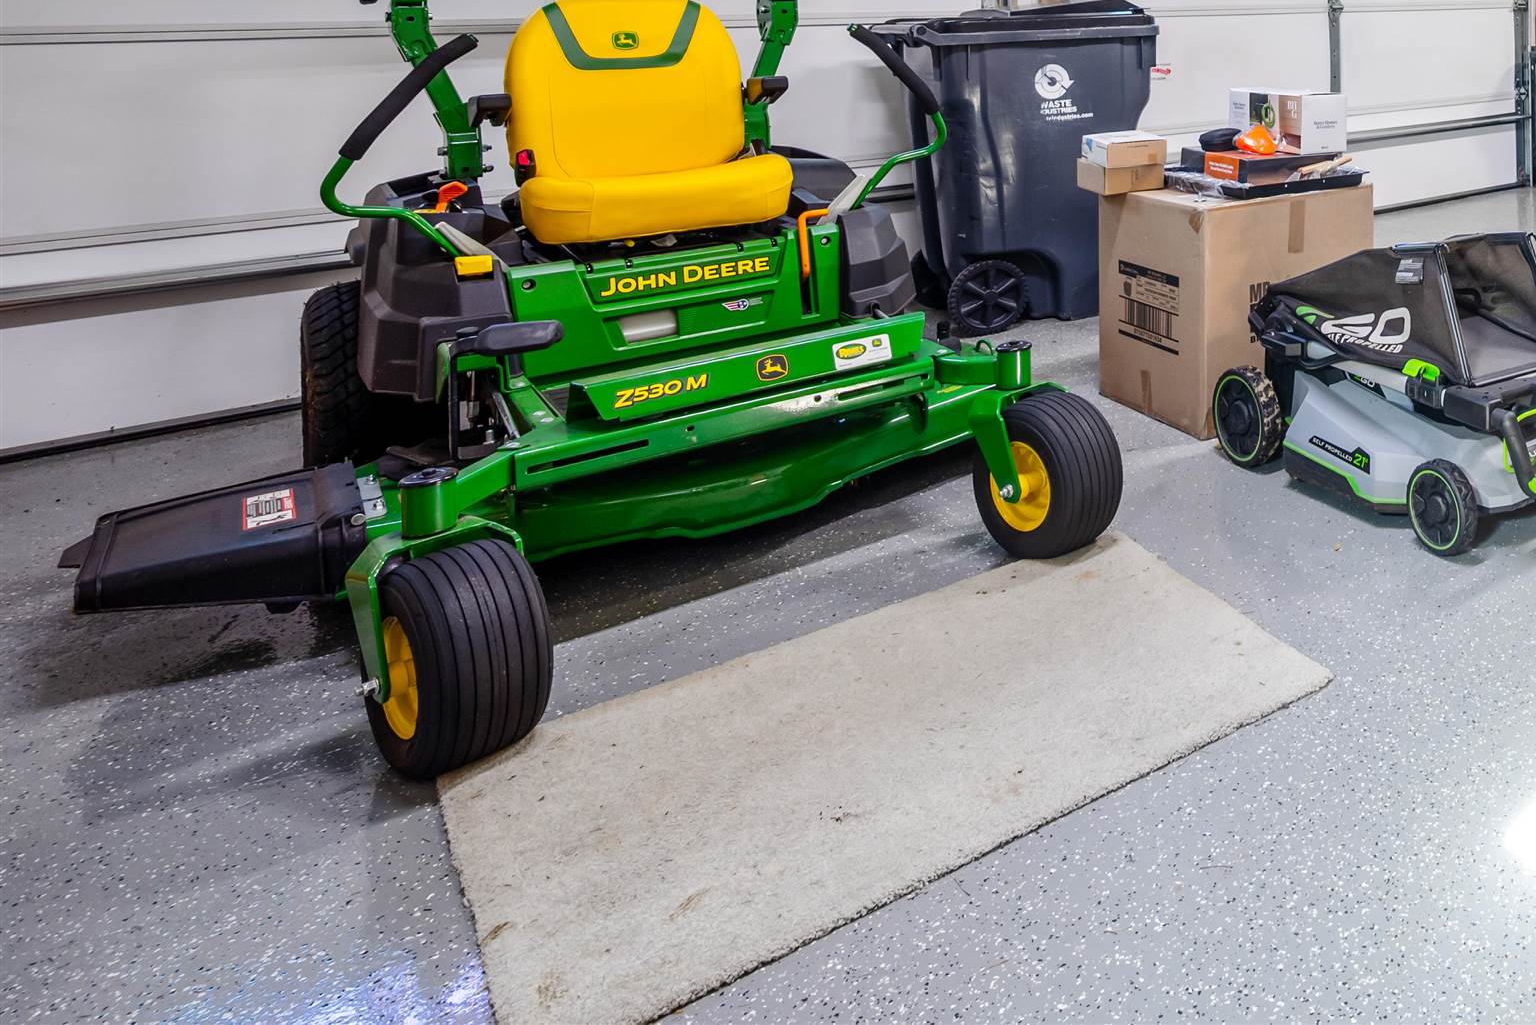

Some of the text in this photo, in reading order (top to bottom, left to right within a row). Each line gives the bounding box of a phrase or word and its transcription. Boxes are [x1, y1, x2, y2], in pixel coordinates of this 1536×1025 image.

[1040, 106, 1078, 115] DUSTRIES
[600, 256, 770, 297] JOHN DEERE
[1340, 334, 1404, 354] PROPELLED
[613, 373, 708, 409] Z530 M
[1312, 436, 1353, 462] SELF PROPELLED
